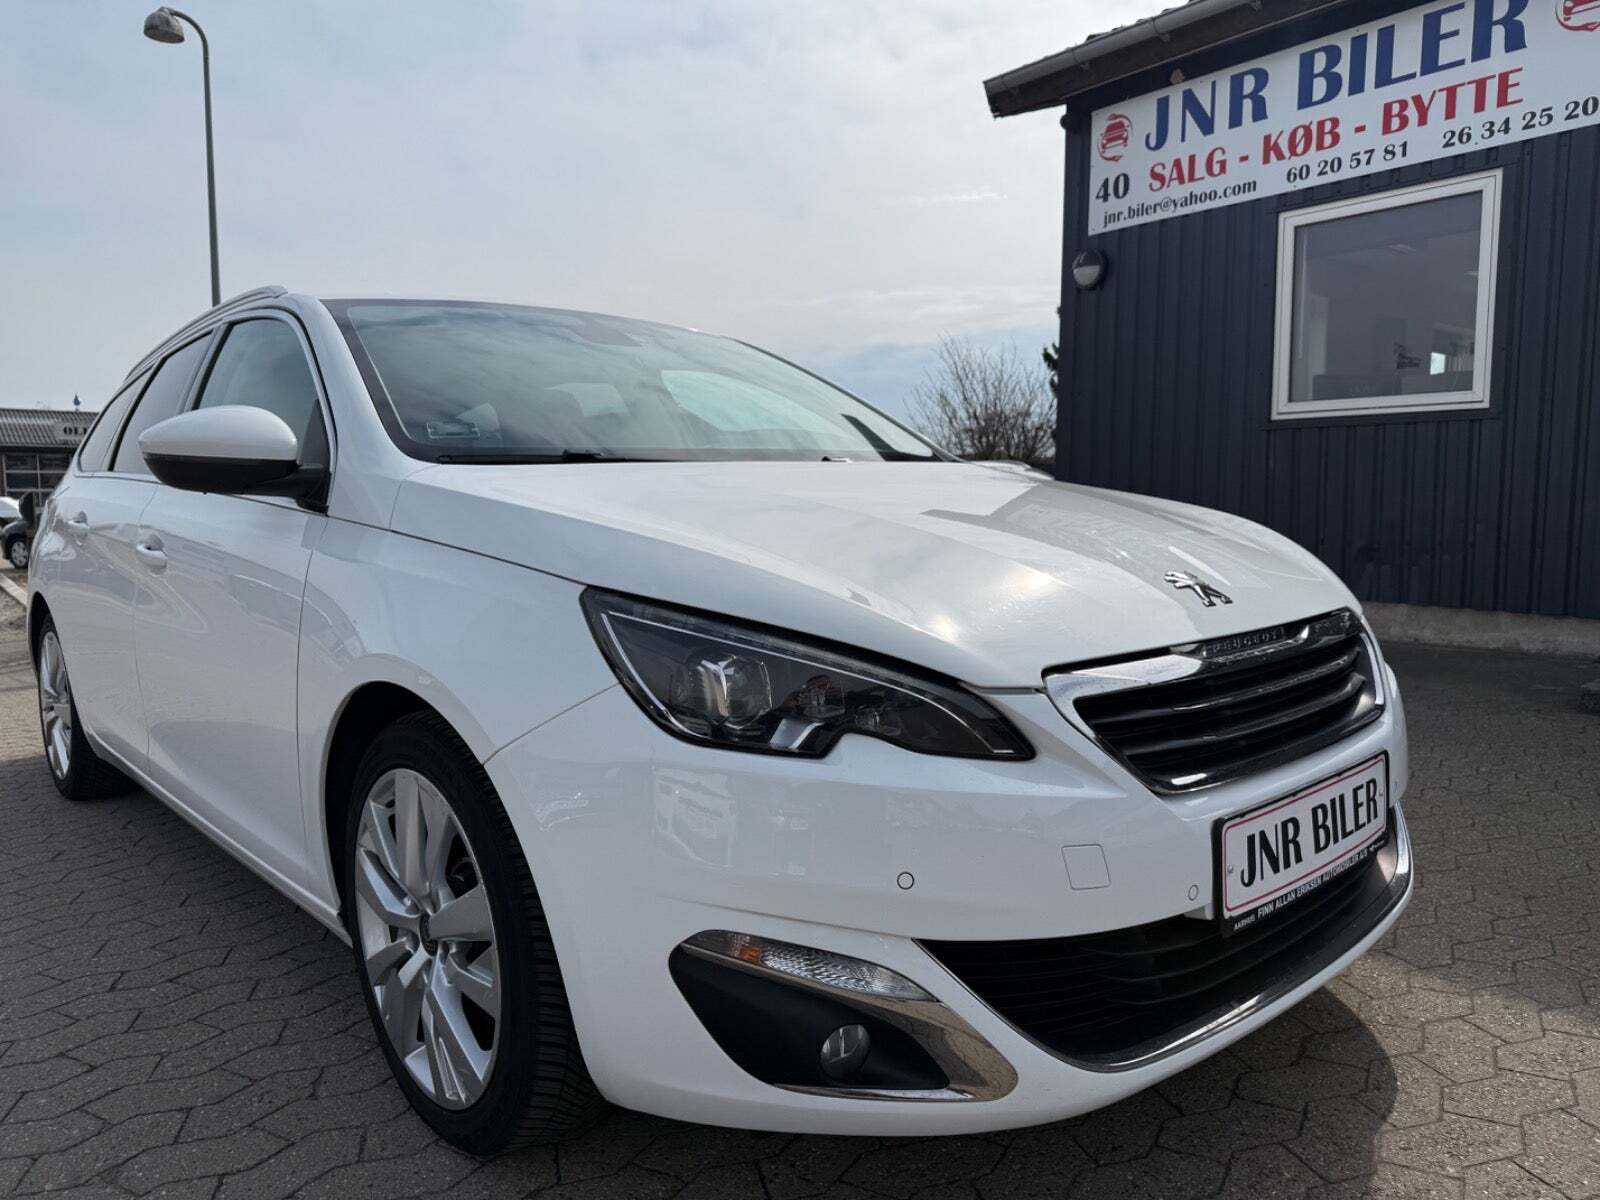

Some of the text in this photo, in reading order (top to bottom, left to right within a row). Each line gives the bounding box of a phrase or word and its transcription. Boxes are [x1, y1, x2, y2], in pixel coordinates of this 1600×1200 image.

[1145, 0, 1528, 151] JNR BILER
[1149, 147, 1227, 193] SALG
[1262, 117, 1341, 166] KØB
[1382, 67, 1524, 136] BYTTE
[1442, 96, 1600, 148] 26 34 25 20
[1286, 140, 1408, 184] 60 20 57 81
[1095, 172, 1130, 204] 40
[1103, 180, 1257, 228] jnr.biler@yahoo.com
[1240, 778, 1378, 888] JNR BILER
[1257, 901, 1274, 919] FINN
[1275, 891, 1296, 909] ALLAN
[1297, 876, 1322, 896] ERIKSEN
